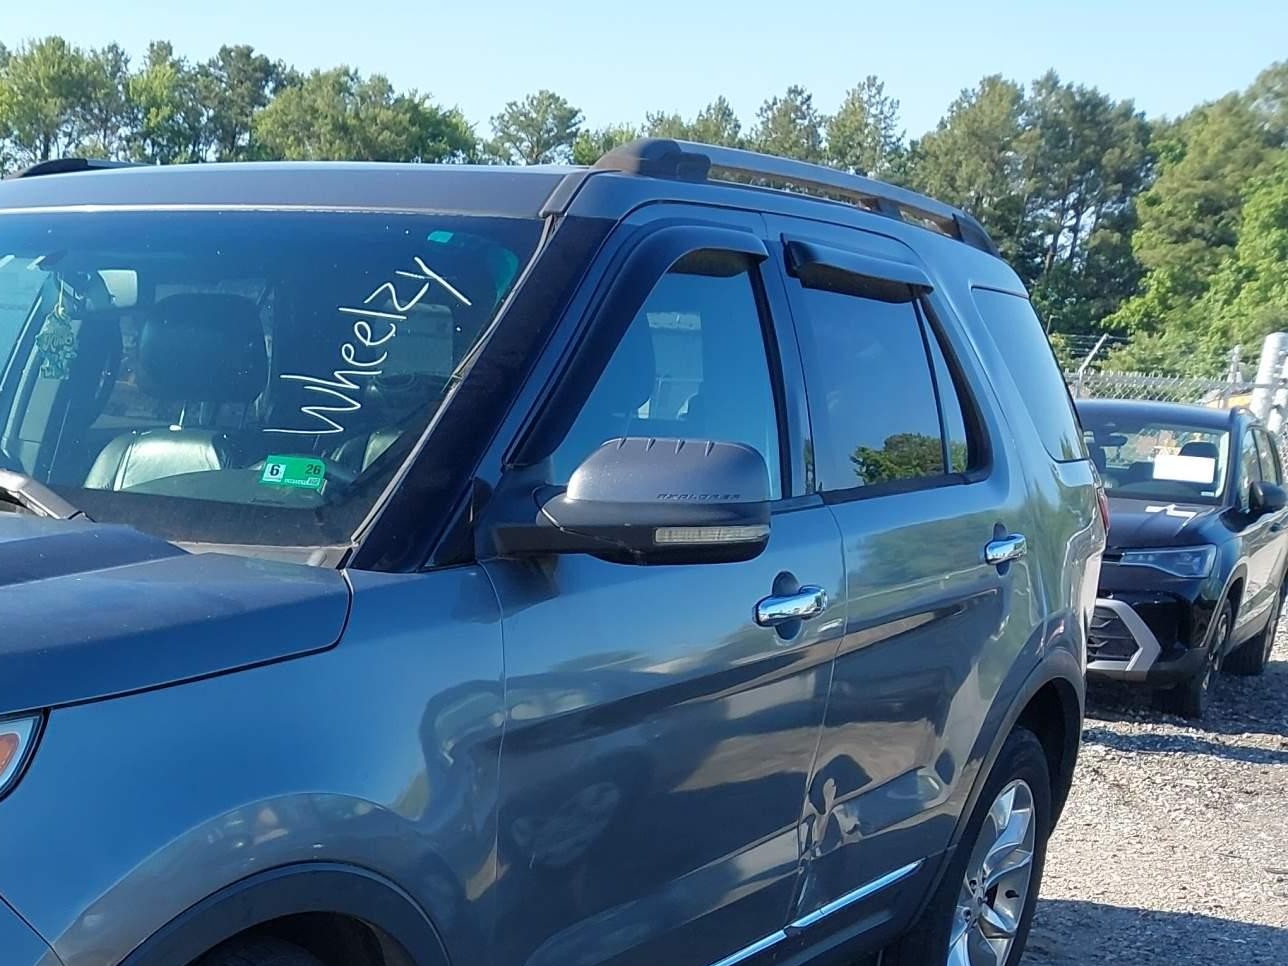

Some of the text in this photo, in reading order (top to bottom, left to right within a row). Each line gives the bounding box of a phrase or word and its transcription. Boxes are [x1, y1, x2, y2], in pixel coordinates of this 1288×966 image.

[263, 256, 472, 434] Wheelzy
[269, 464, 322, 476] 6 26
